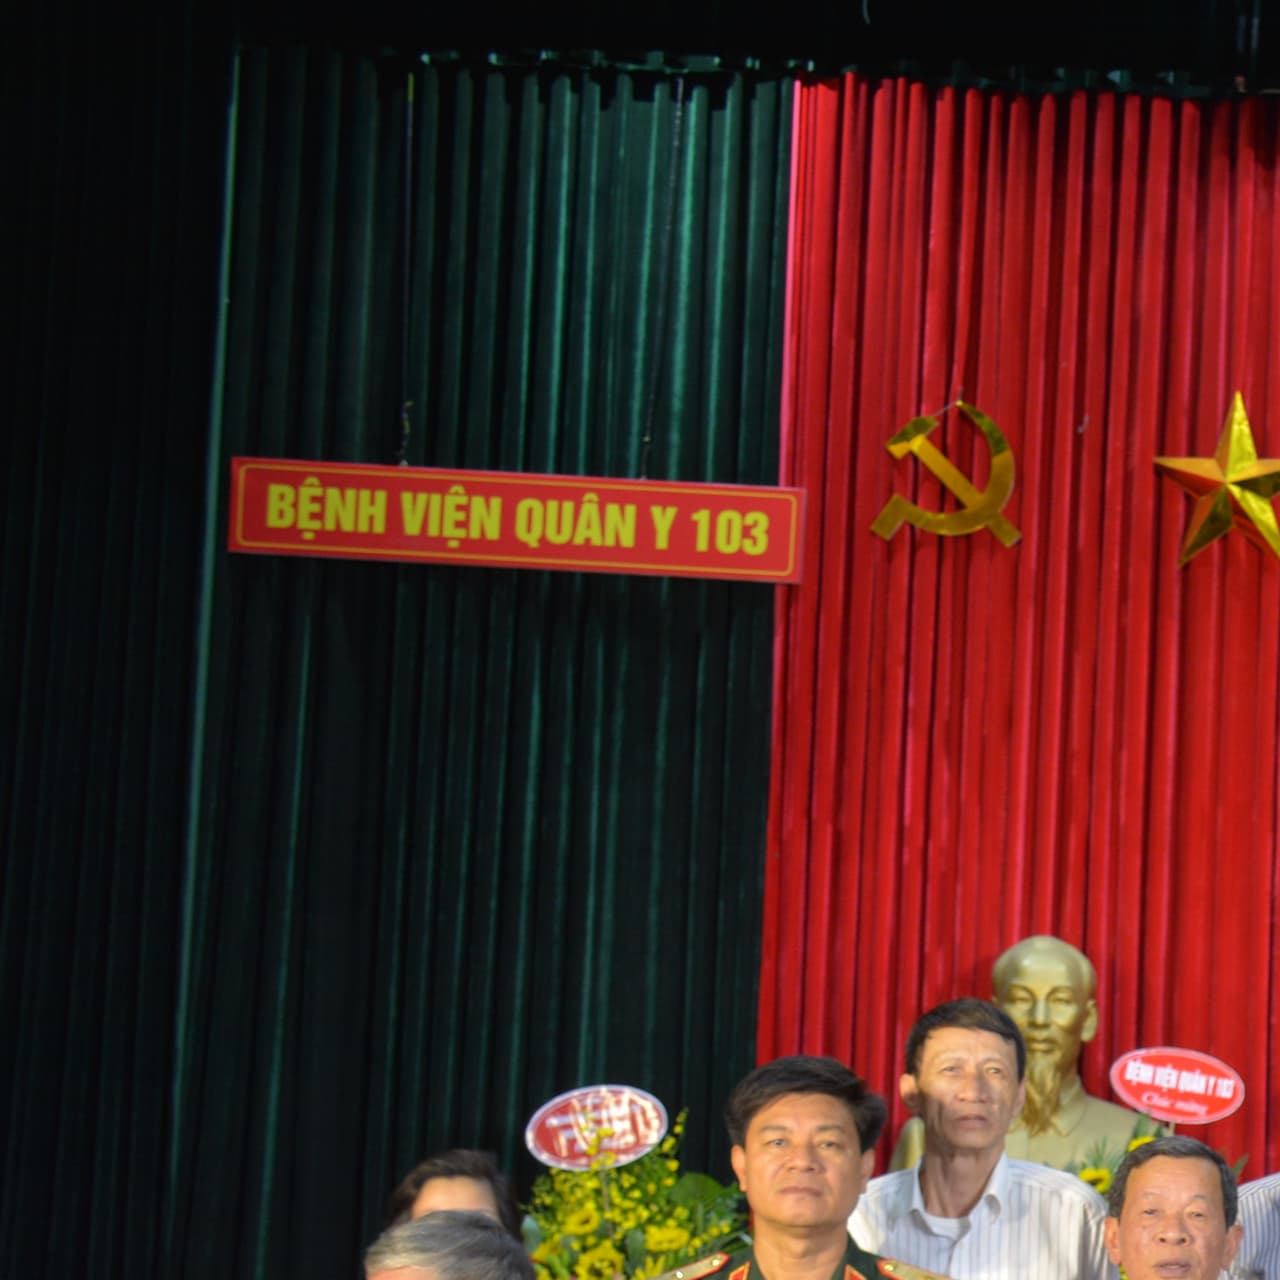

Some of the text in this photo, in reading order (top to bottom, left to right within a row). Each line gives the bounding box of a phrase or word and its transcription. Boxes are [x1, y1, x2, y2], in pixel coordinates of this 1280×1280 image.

[267, 477, 770, 556] BỆNH VIỆN QUÂN Y 103
